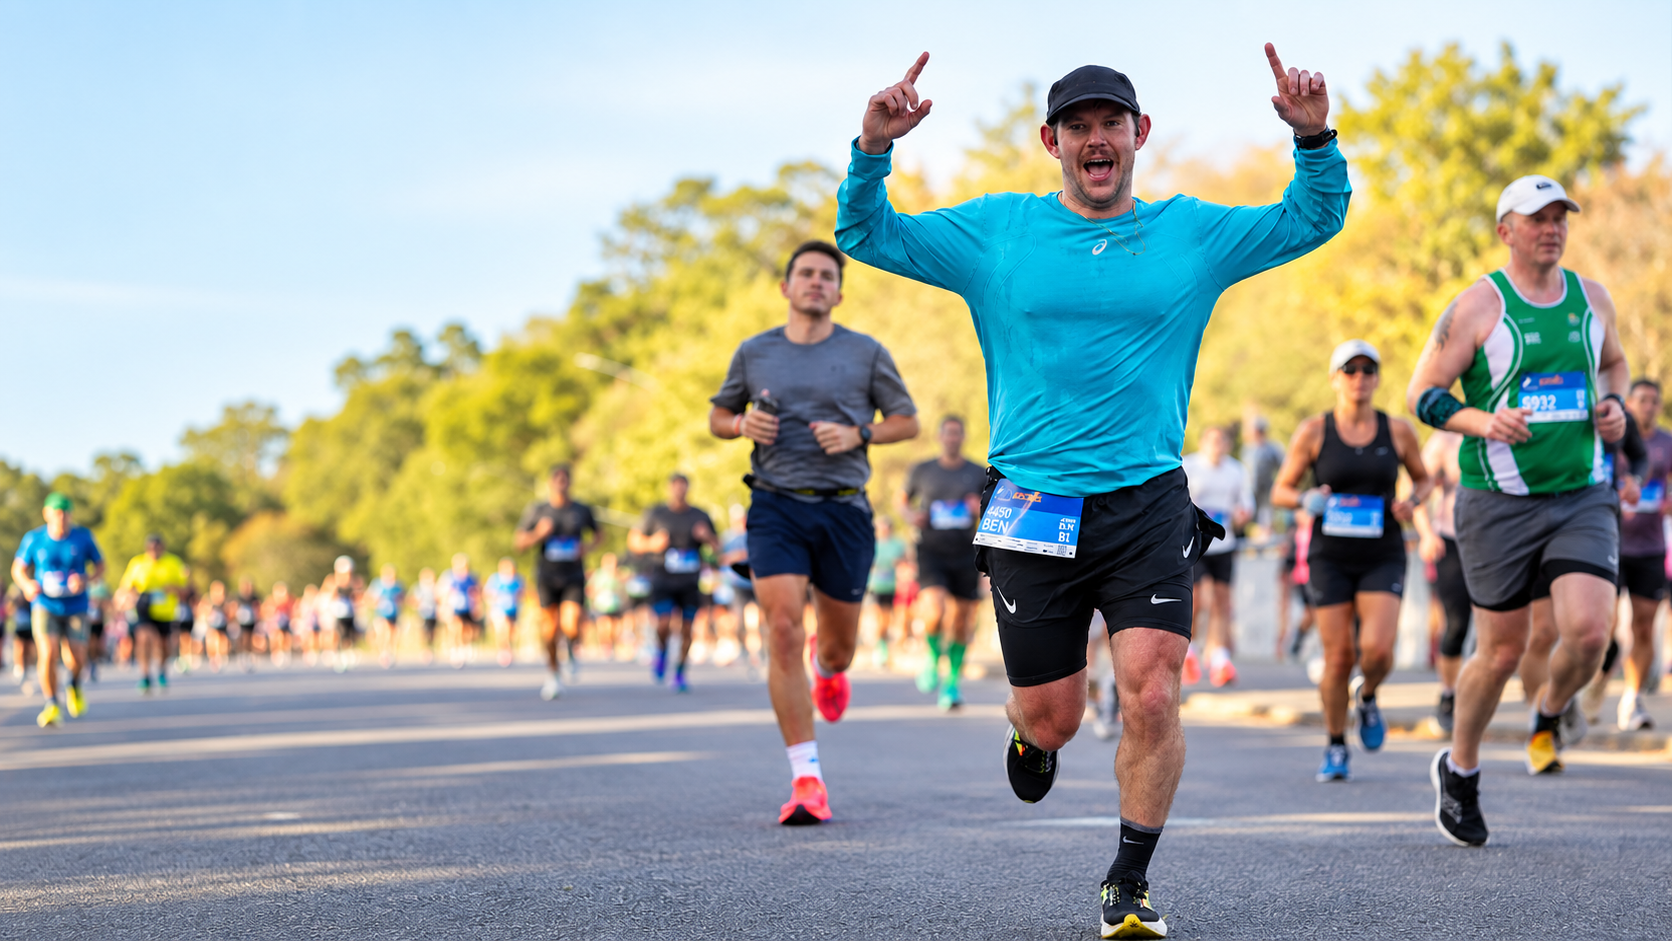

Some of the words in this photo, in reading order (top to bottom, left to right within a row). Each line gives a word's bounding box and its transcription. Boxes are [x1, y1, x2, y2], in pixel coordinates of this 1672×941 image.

[987, 505, 1012, 519] 4450
[982, 518, 1009, 534] BEN
[1058, 532, 1070, 542] B1
